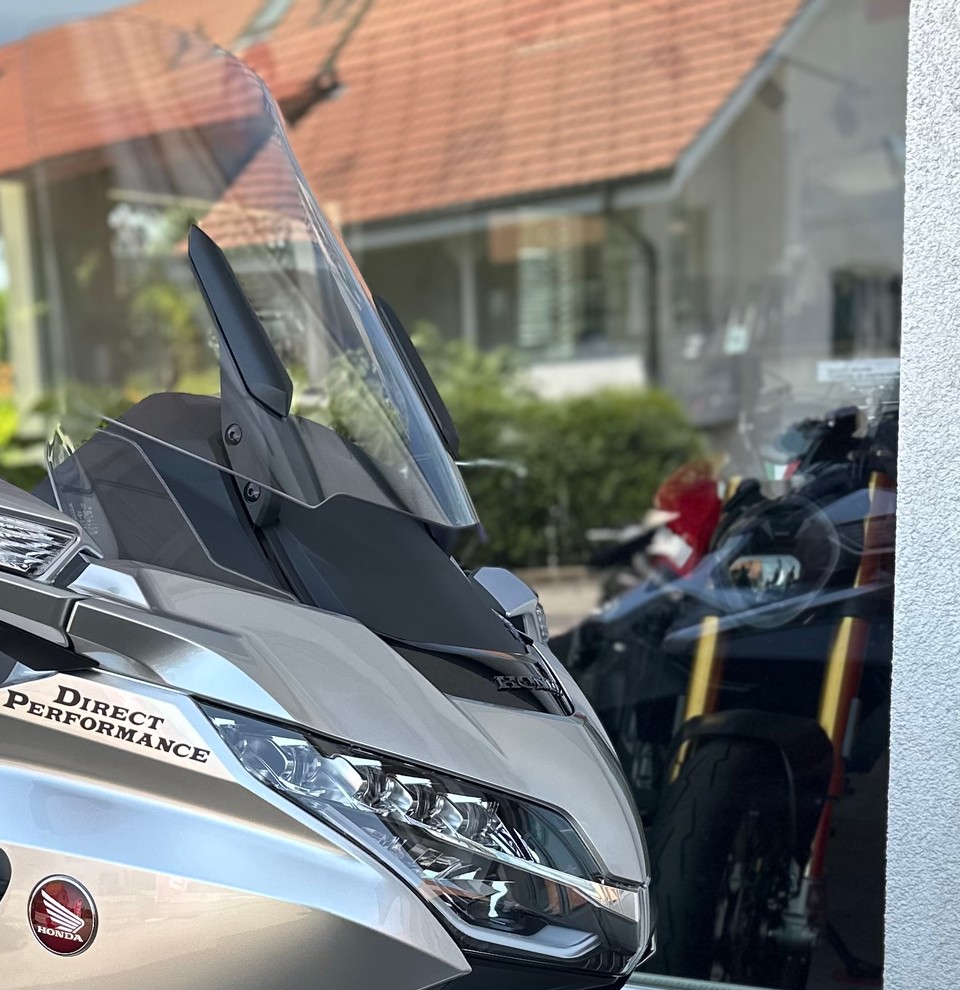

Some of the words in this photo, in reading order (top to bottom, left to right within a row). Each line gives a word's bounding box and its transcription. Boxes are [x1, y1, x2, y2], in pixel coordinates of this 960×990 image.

[2, 689, 211, 764] PERFORMANCE
[52, 685, 165, 731] DIRECT
[36, 925, 84, 943] HONDA
